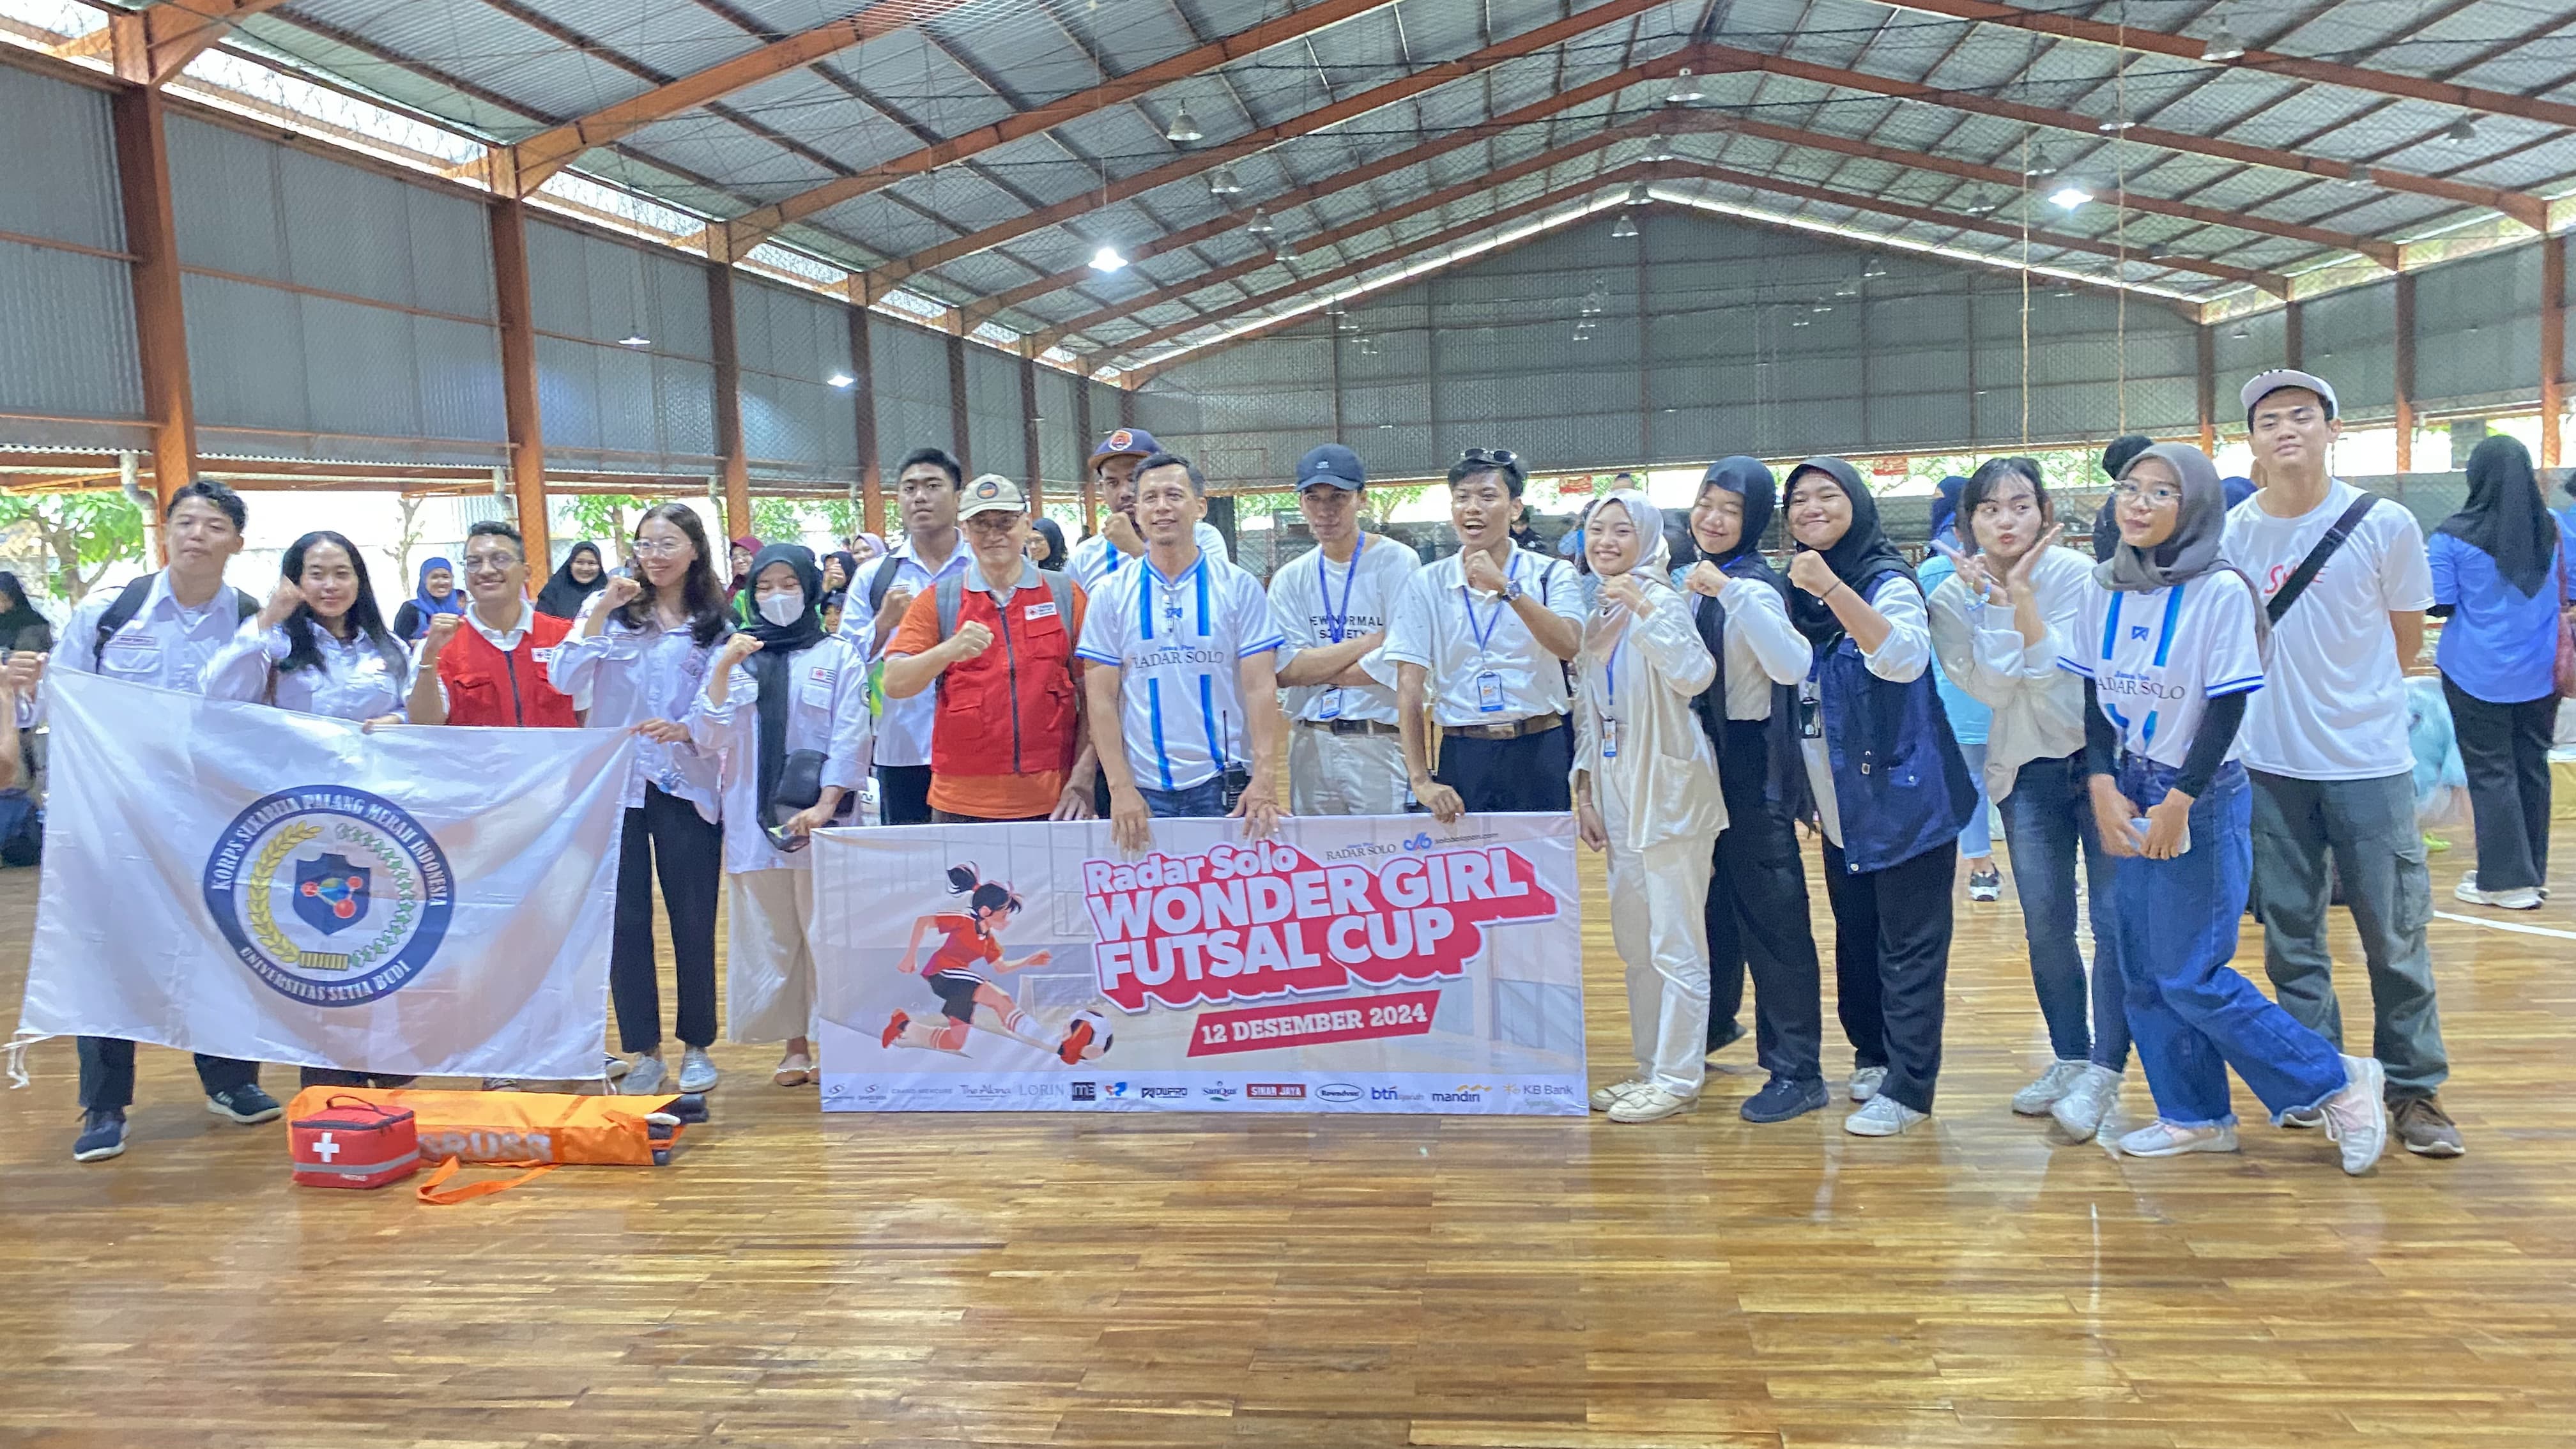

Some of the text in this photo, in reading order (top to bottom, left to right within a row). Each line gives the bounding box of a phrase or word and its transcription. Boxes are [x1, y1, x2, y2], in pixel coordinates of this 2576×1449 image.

[1186, 650, 1224, 663] SOLO
[2140, 682, 2185, 700] SOLO
[300, 793, 366, 815] PALANG
[364, 804, 417, 843] MERAH
[408, 838, 448, 907] INDONESIA
[1326, 847, 1366, 861] RADAR
[1367, 843, 1396, 855] SOLO
[210, 839, 246, 891] KORPS
[1091, 841, 1299, 895] Radar Solo
[1087, 847, 1529, 942] WONDER GIRL
[1097, 907, 1455, 990] FUTSAL CUP
[239, 946, 412, 1001] UNIVERSITAS SETIA BUDI
[1201, 1002, 1428, 1045] 12 DESEMBER 2024
[1020, 1084, 1064, 1096] LORIN
[1279, 1085, 1301, 1096] JAYA
[1371, 1086, 1398, 1100] btn
[1432, 1091, 1481, 1103] mandiri
[1523, 1085, 1574, 1095] KB Bank
